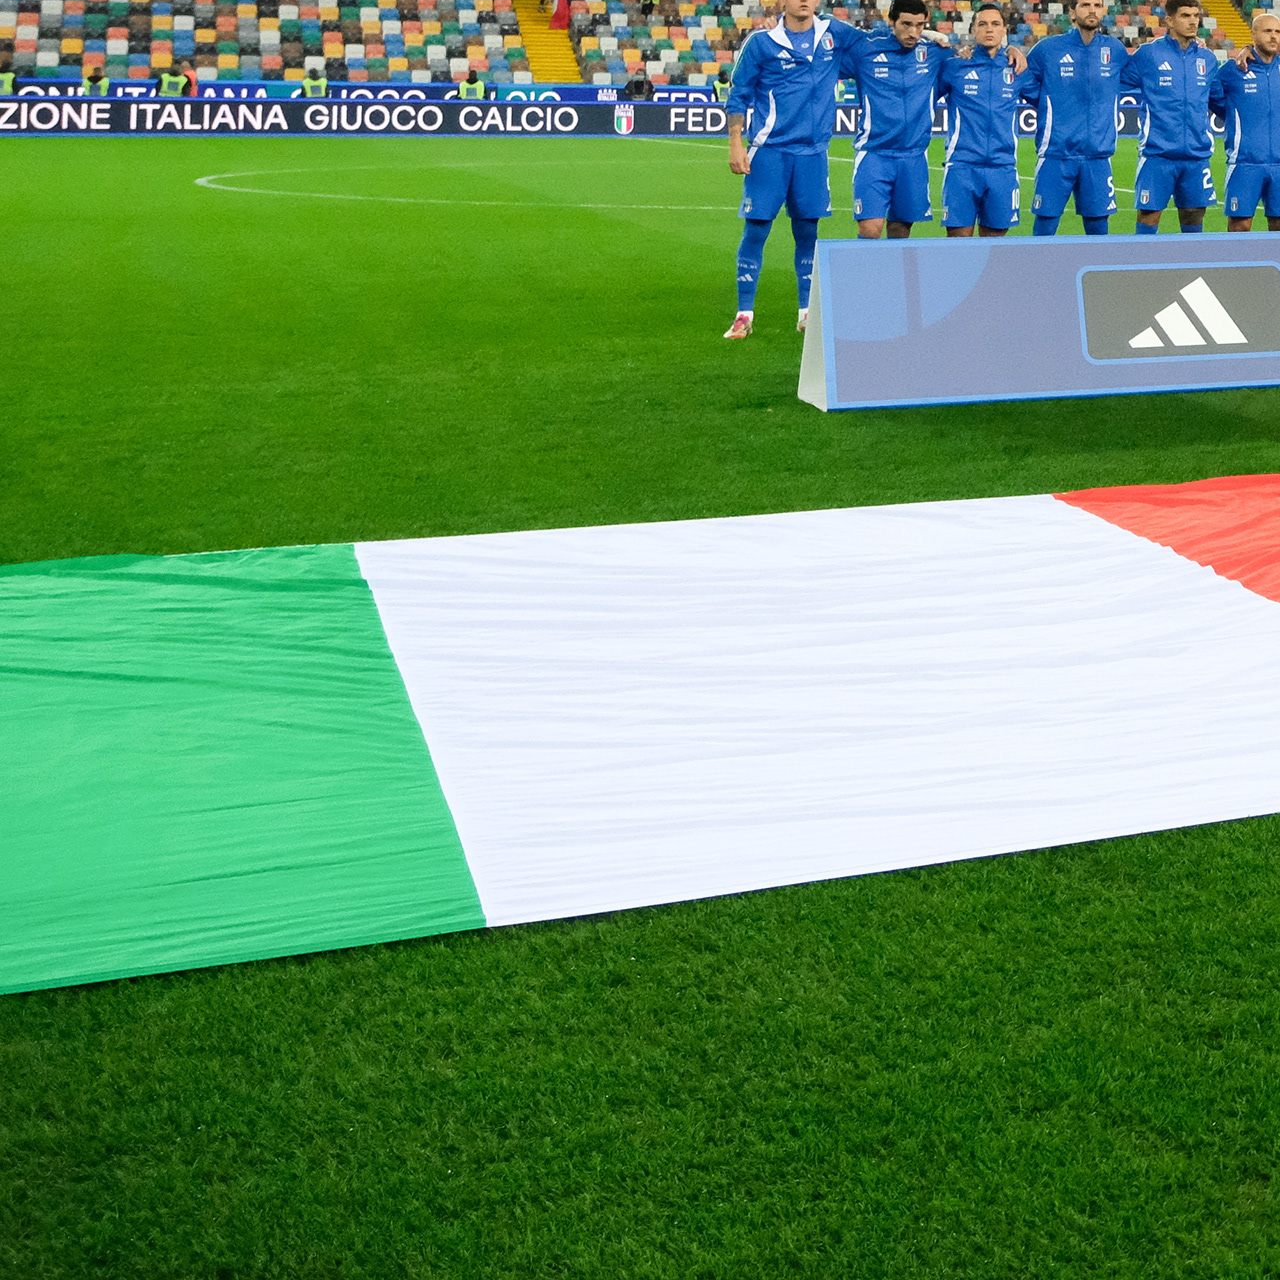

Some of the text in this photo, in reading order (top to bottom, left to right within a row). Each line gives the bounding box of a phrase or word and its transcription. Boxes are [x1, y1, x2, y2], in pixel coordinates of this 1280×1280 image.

[129, 103, 289, 131] ITALIANA
[303, 104, 444, 132] GIUOCO
[458, 105, 579, 133] CALCIO
[1011, 188, 1020, 210] 10
